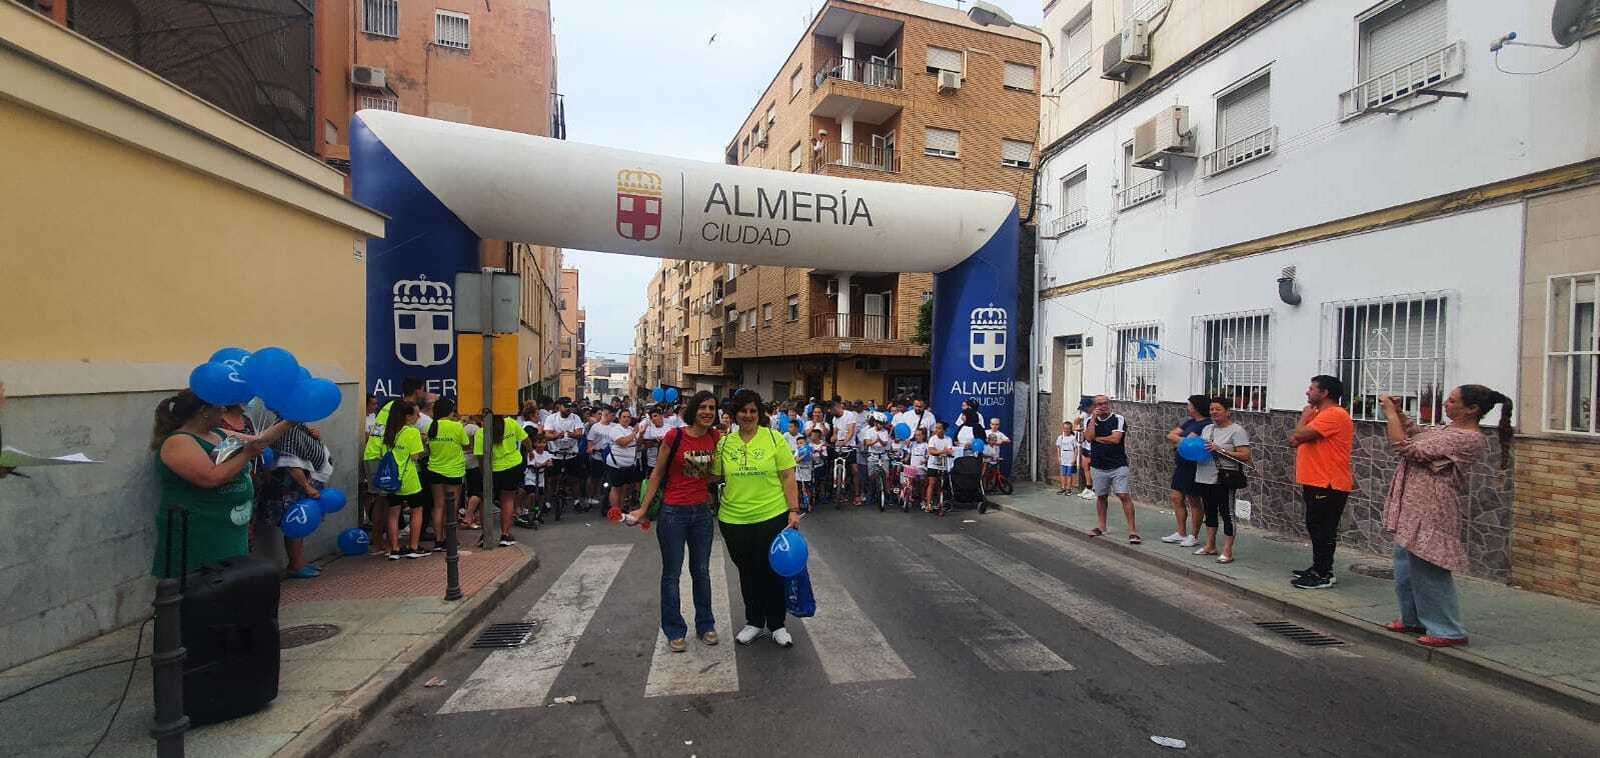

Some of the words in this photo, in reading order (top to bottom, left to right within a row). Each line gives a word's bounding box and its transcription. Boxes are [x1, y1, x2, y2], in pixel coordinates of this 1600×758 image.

[704, 182, 874, 226] ALMERÍA
[701, 222, 790, 246] CIUDAD
[373, 378, 457, 397] ALER
[950, 378, 1014, 395] ALMERÍA
